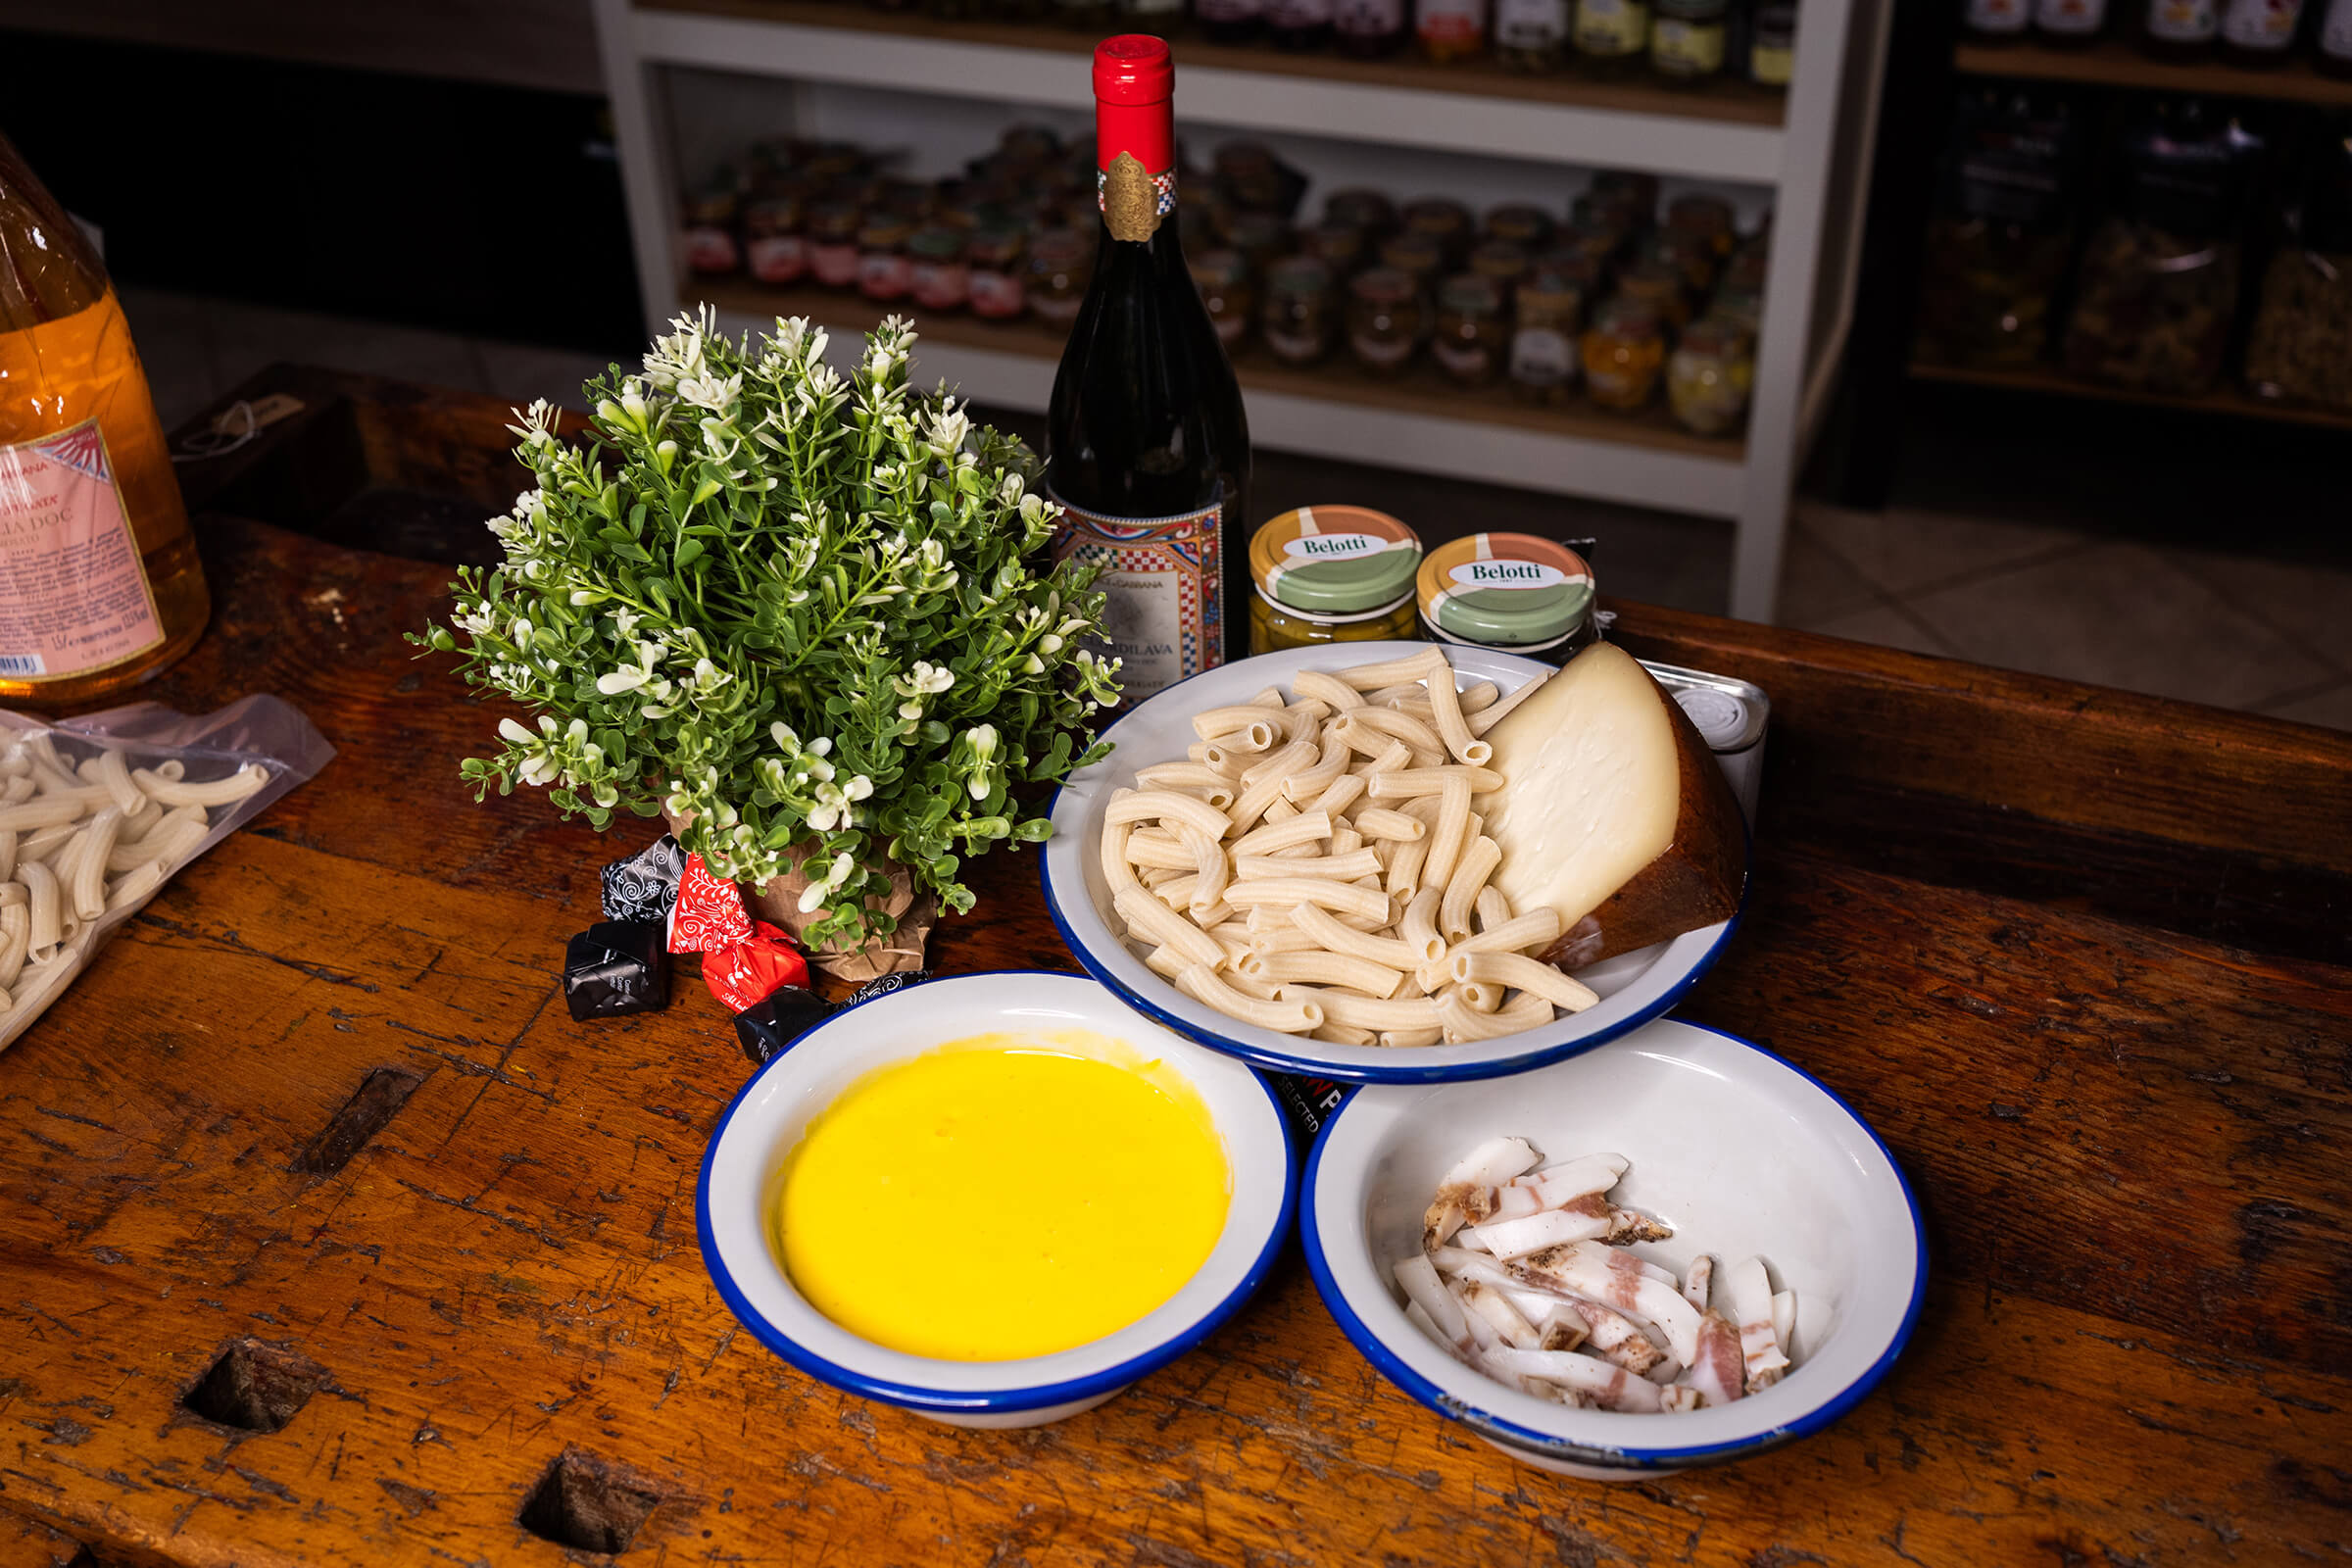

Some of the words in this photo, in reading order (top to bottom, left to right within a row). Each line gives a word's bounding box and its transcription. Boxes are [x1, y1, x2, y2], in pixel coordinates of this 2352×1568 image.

[1303, 535, 1368, 555] Belotti
[1472, 564, 1542, 580] Belotti
[1277, 1074, 1319, 1133] SELECTED
